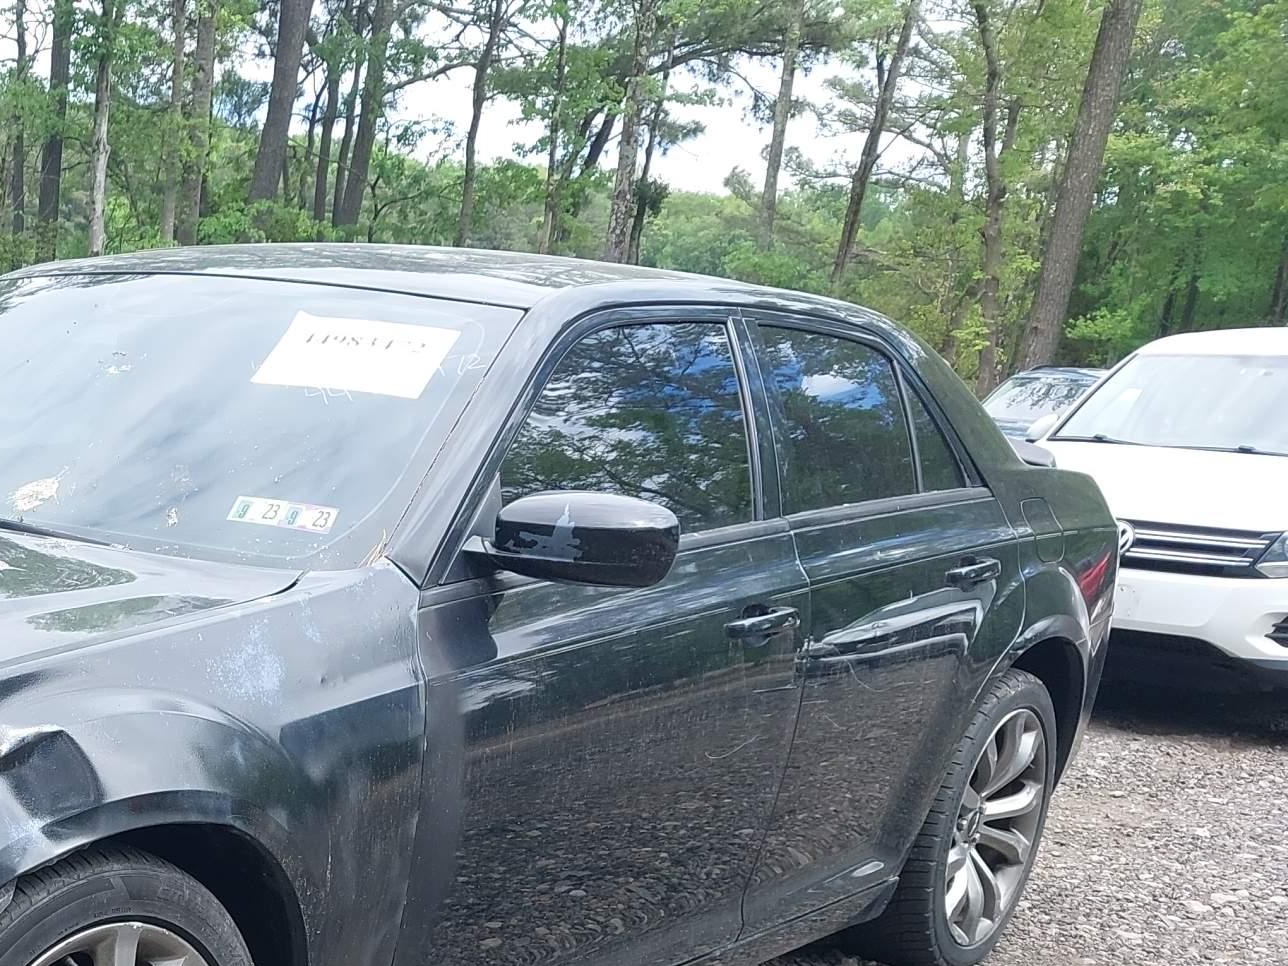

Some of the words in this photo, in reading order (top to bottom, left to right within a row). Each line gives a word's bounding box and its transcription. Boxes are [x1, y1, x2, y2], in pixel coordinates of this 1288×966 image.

[239, 504, 250, 519] 9
[262, 504, 281, 520] 23
[288, 511, 299, 525] 9
[312, 511, 331, 528] 23
